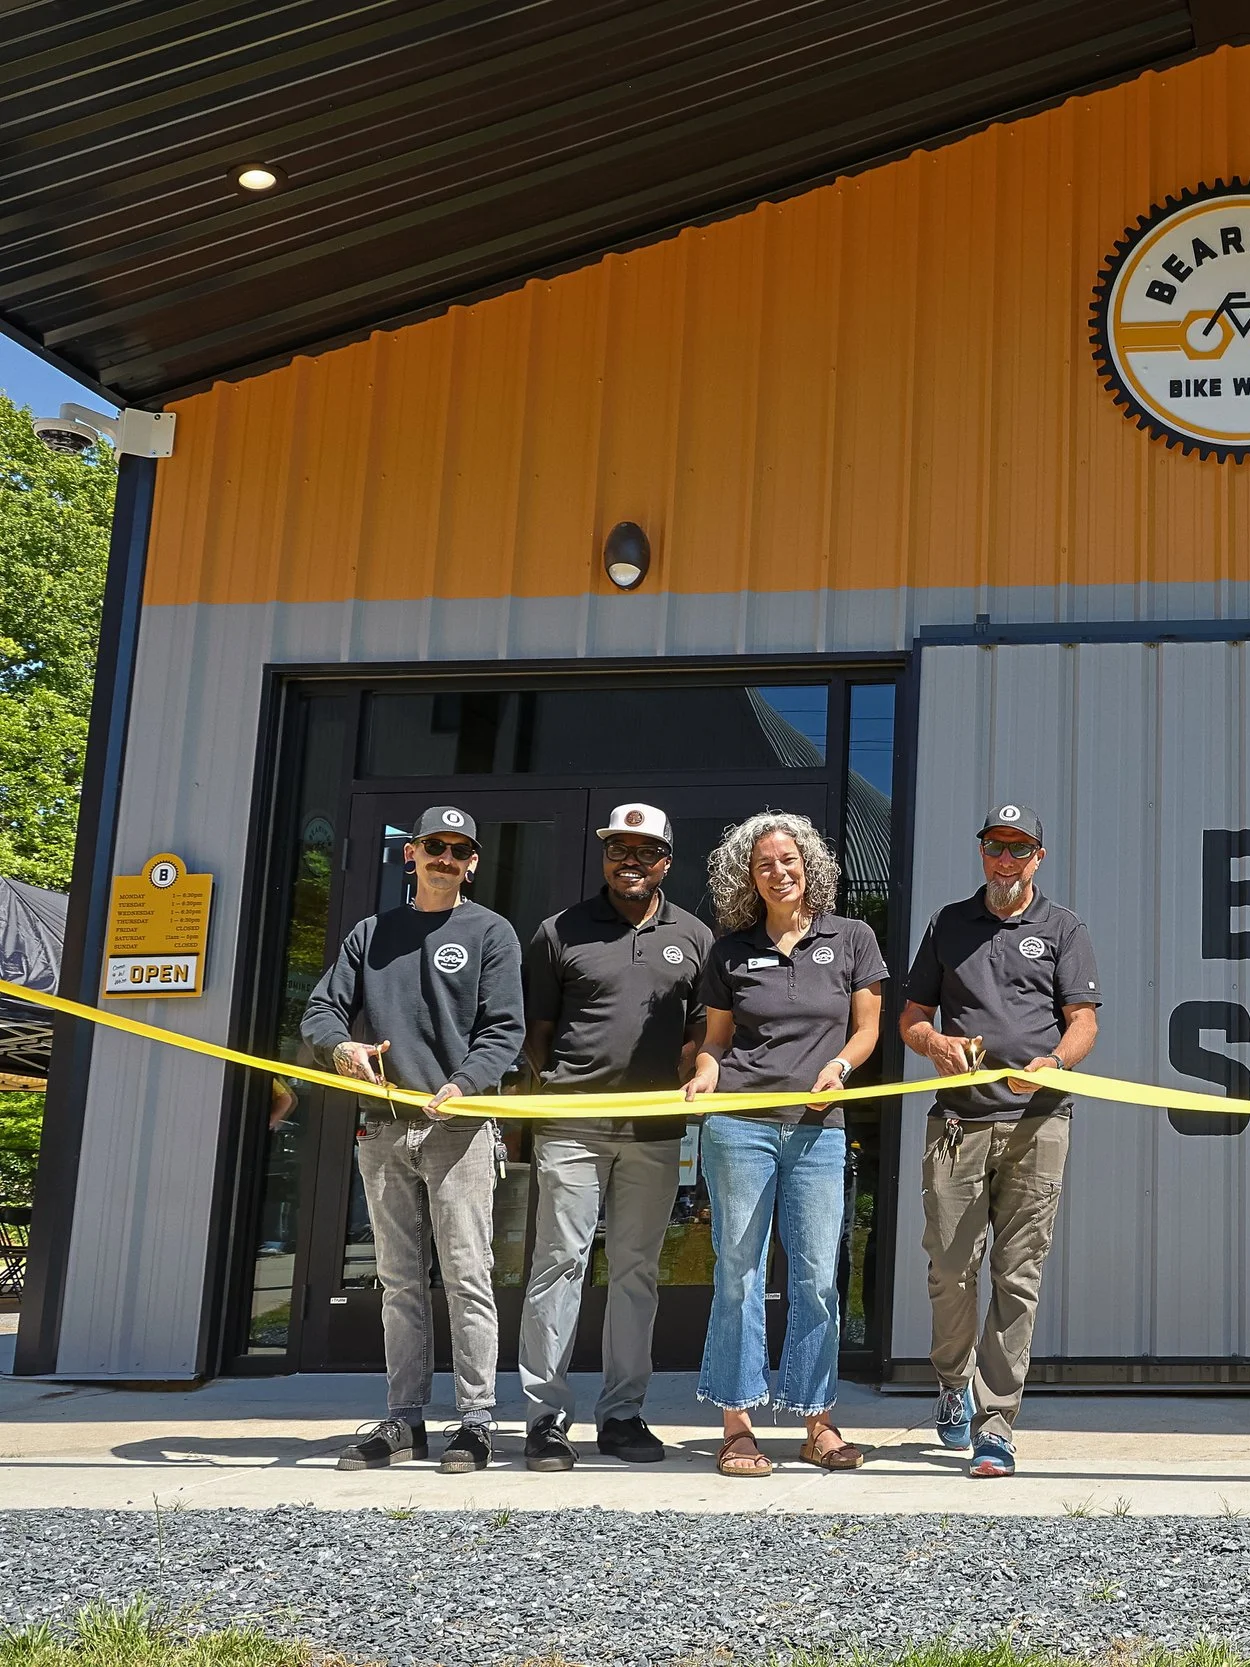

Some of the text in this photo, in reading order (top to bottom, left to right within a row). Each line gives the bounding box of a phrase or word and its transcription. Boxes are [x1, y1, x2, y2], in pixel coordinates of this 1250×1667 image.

[1169, 378, 1222, 399] BIKE
[159, 869, 169, 881] B
[130, 964, 188, 984] OPEN
